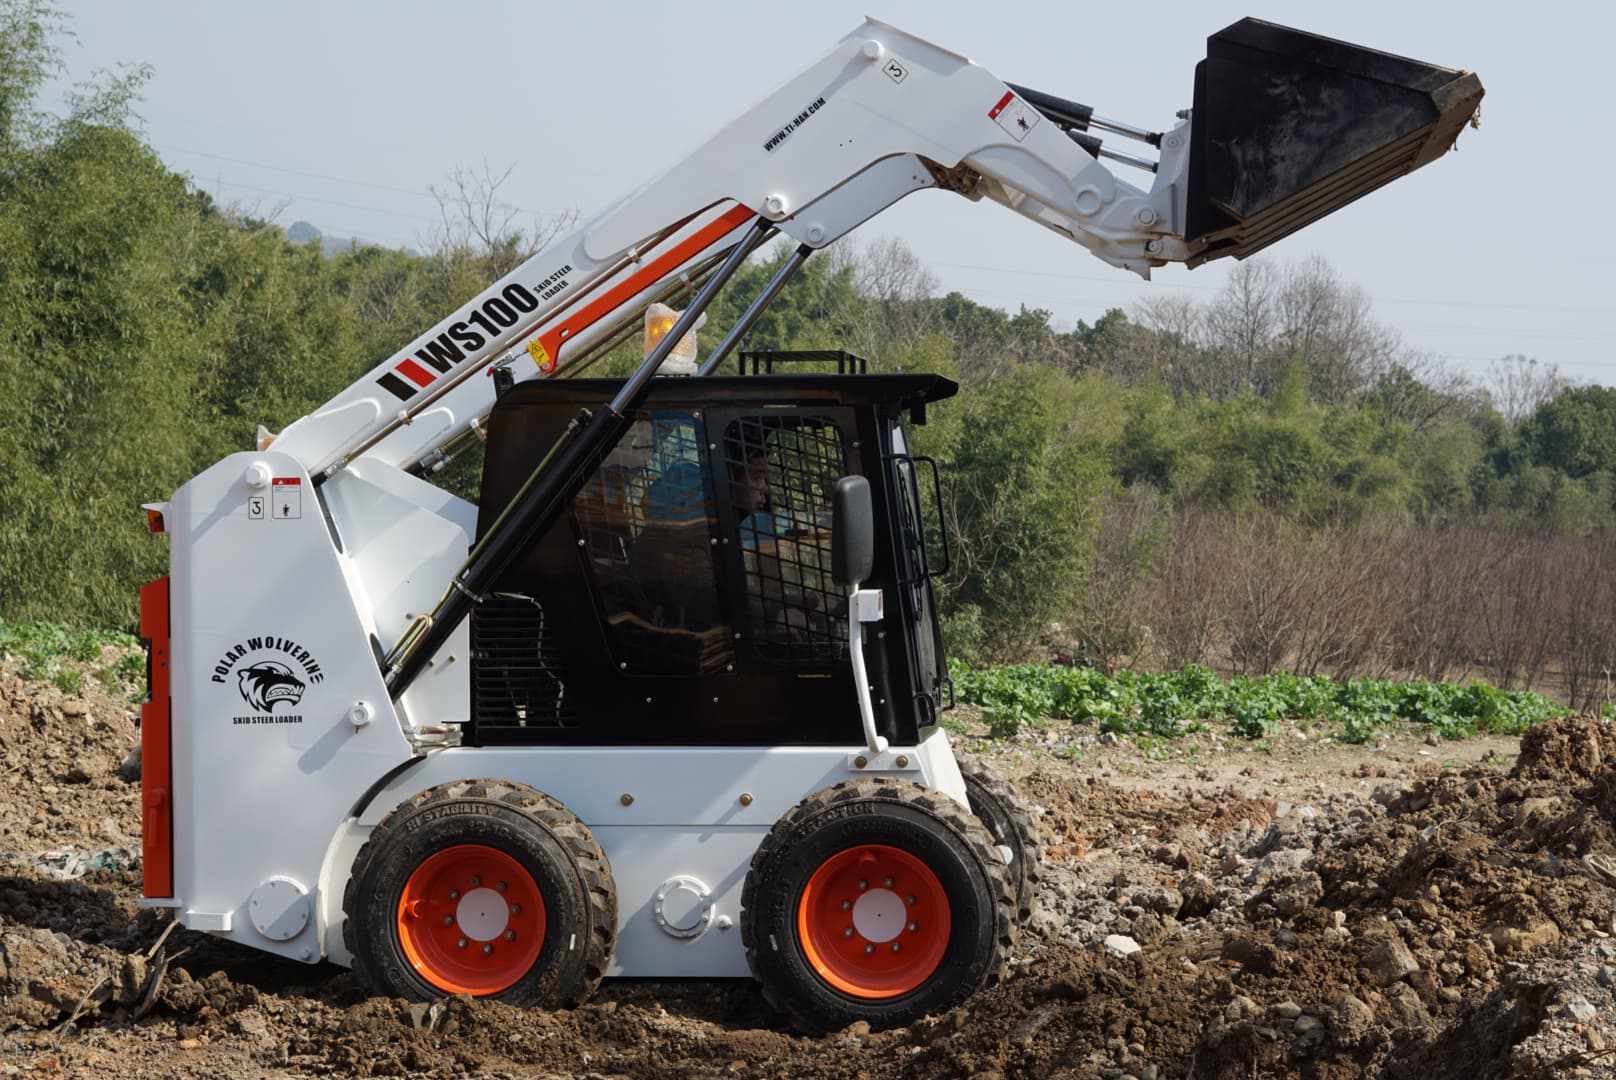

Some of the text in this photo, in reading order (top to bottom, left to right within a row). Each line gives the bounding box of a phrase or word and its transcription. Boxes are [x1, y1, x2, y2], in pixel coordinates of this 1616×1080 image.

[533, 264, 573, 293] SKID STEER
[541, 279, 569, 300] LOADER
[414, 283, 539, 374] WS100
[211, 636, 324, 685] POLAR WOLVERINE
[233, 715, 303, 725] SKID STEER LOADER
[423, 803, 496, 821] STABILITY
